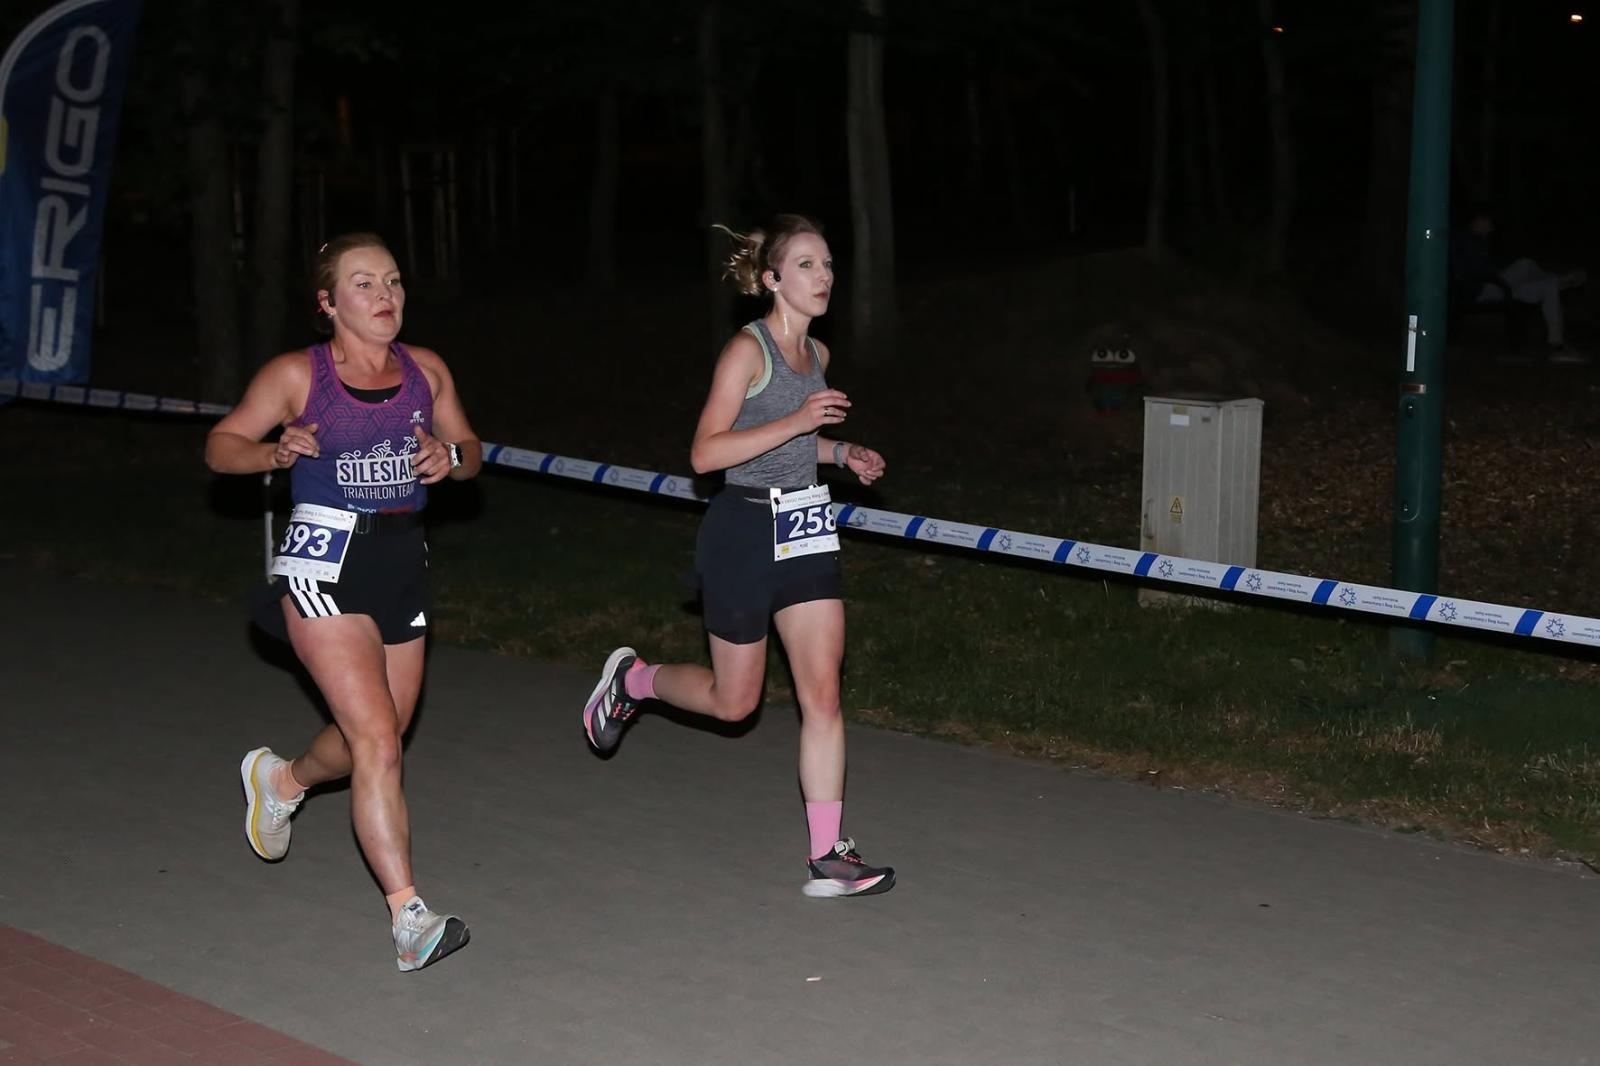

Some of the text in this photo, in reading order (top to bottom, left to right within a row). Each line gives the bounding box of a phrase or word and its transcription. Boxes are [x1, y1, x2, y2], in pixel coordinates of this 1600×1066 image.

[27, 25, 111, 371] ERIGO
[342, 486, 396, 500] TRIATHLON
[788, 504, 837, 539] 258
[280, 523, 332, 557] 393
